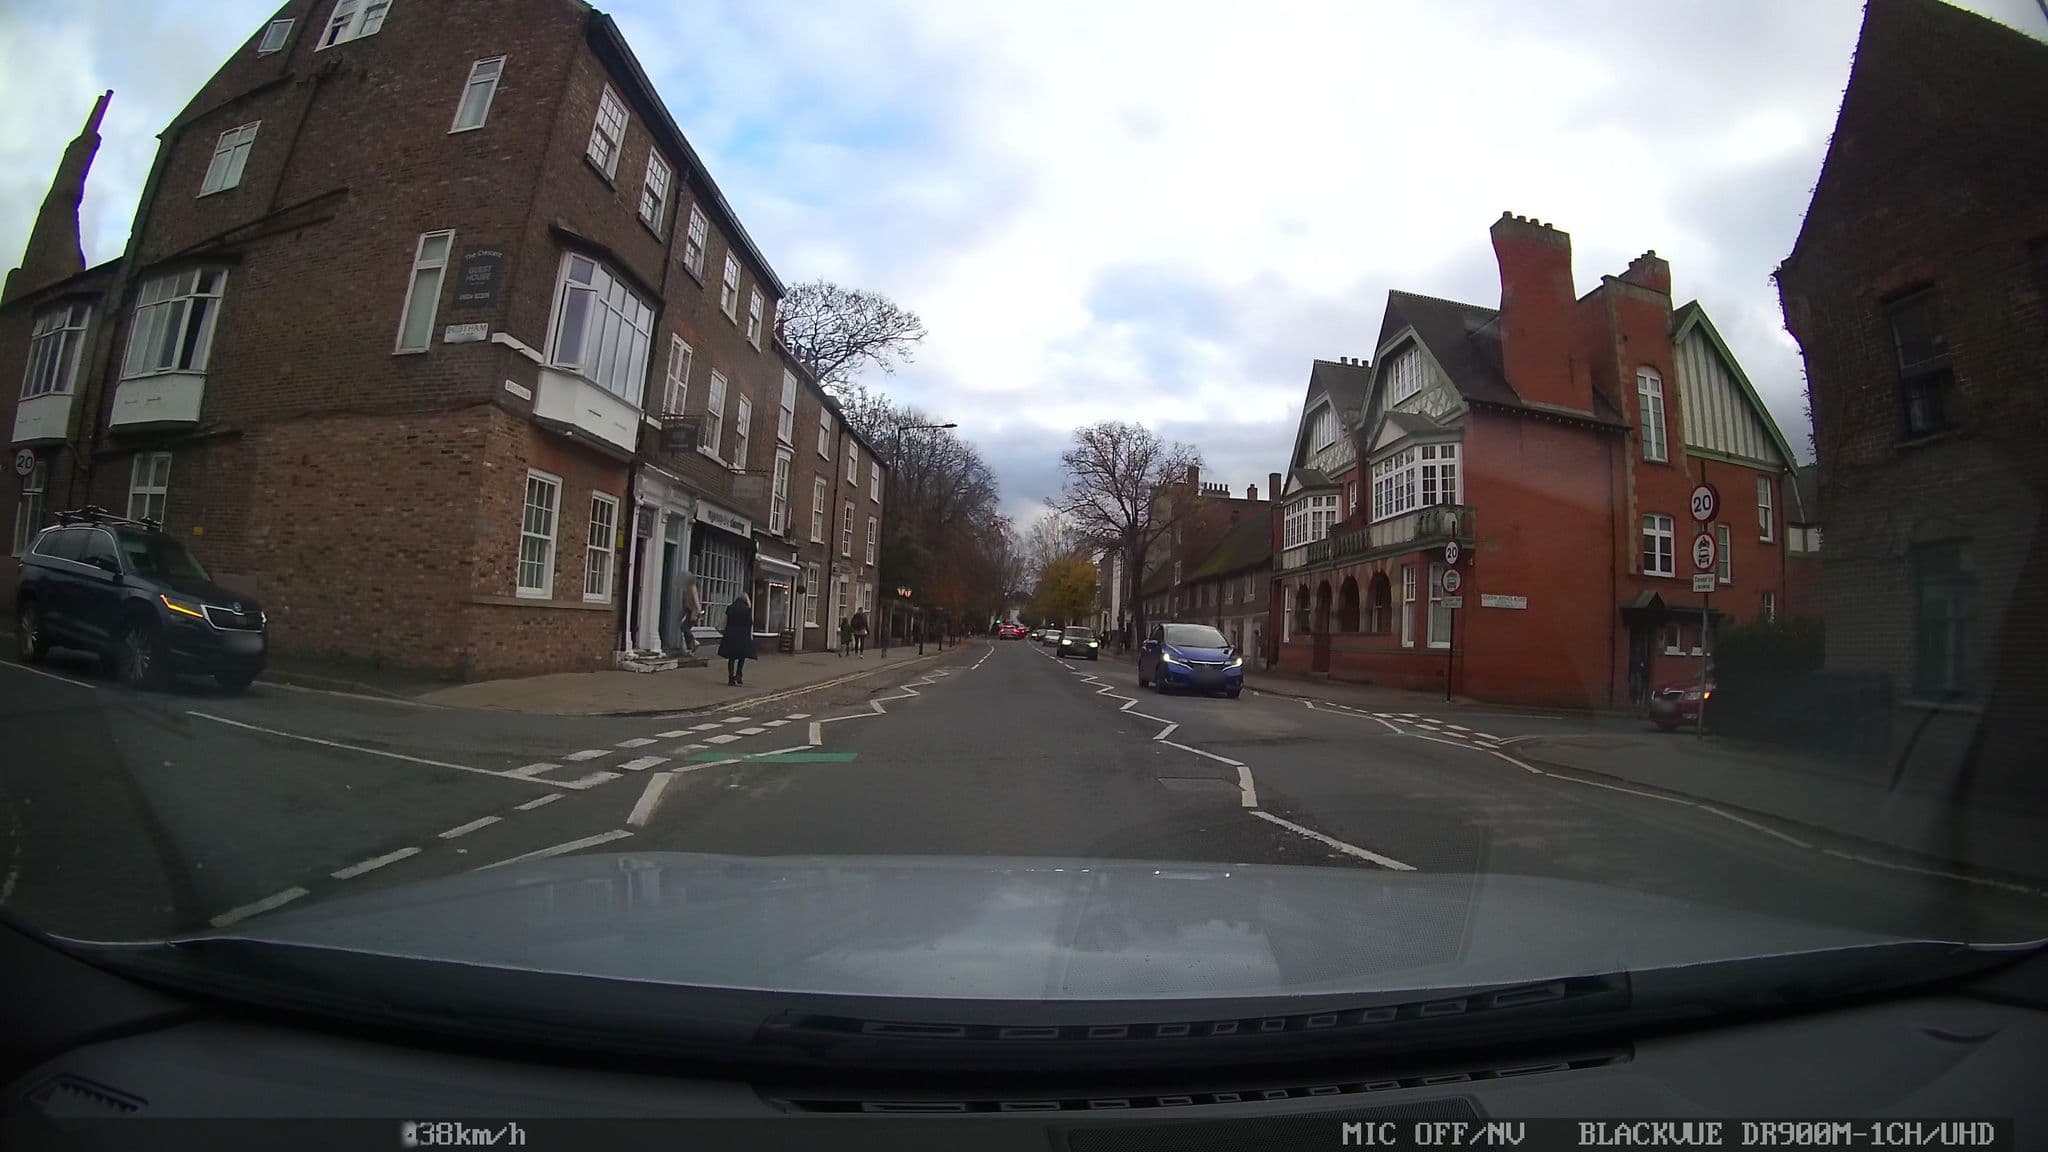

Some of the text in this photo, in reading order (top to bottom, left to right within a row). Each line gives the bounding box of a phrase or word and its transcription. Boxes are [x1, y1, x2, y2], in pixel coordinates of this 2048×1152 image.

[17, 455, 33, 468] 20
[1694, 495, 1711, 512] 20
[1447, 547, 1457, 558] 20
